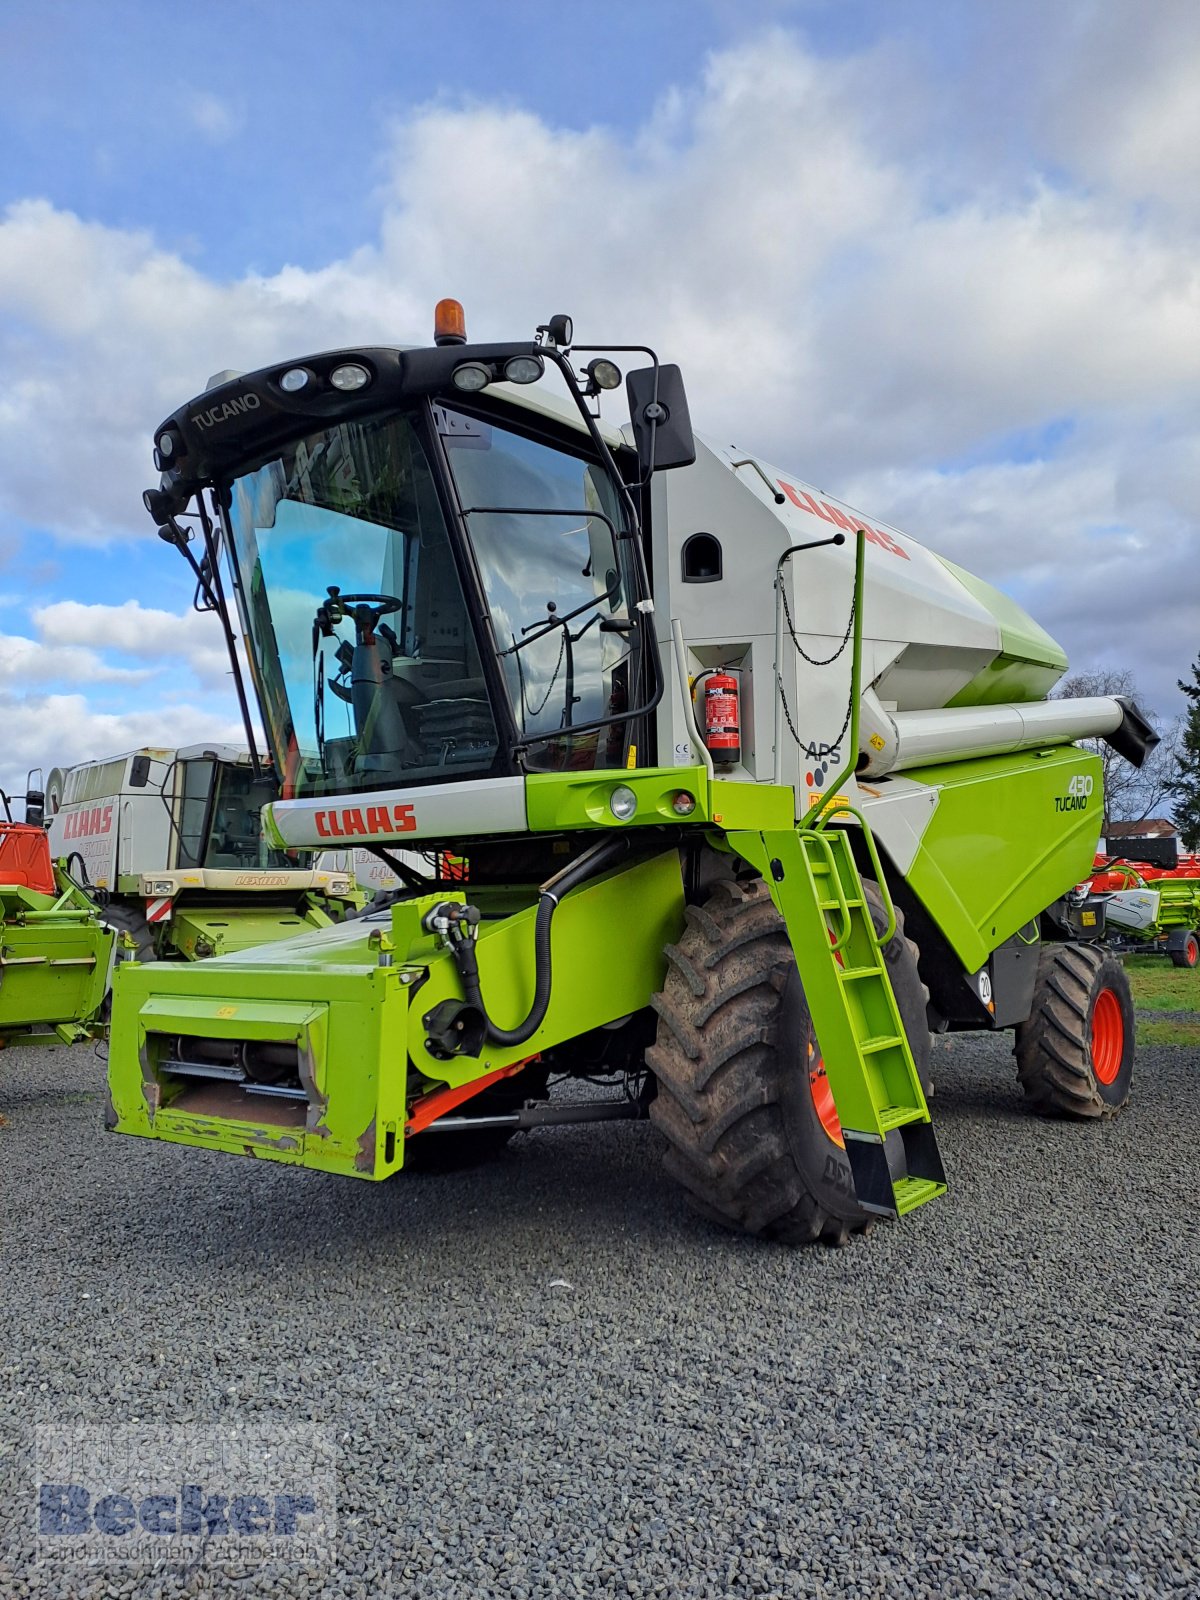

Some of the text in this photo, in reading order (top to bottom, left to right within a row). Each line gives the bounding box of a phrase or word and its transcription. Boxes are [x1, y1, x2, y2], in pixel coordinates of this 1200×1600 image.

[191, 393, 260, 430] TUCANO
[776, 479, 911, 561] CLAAS
[805, 741, 842, 765] APS
[1068, 775, 1094, 797] 430
[1055, 795, 1087, 812] TUCANO
[63, 804, 113, 840] CLAAS
[314, 804, 417, 837] CLAAS
